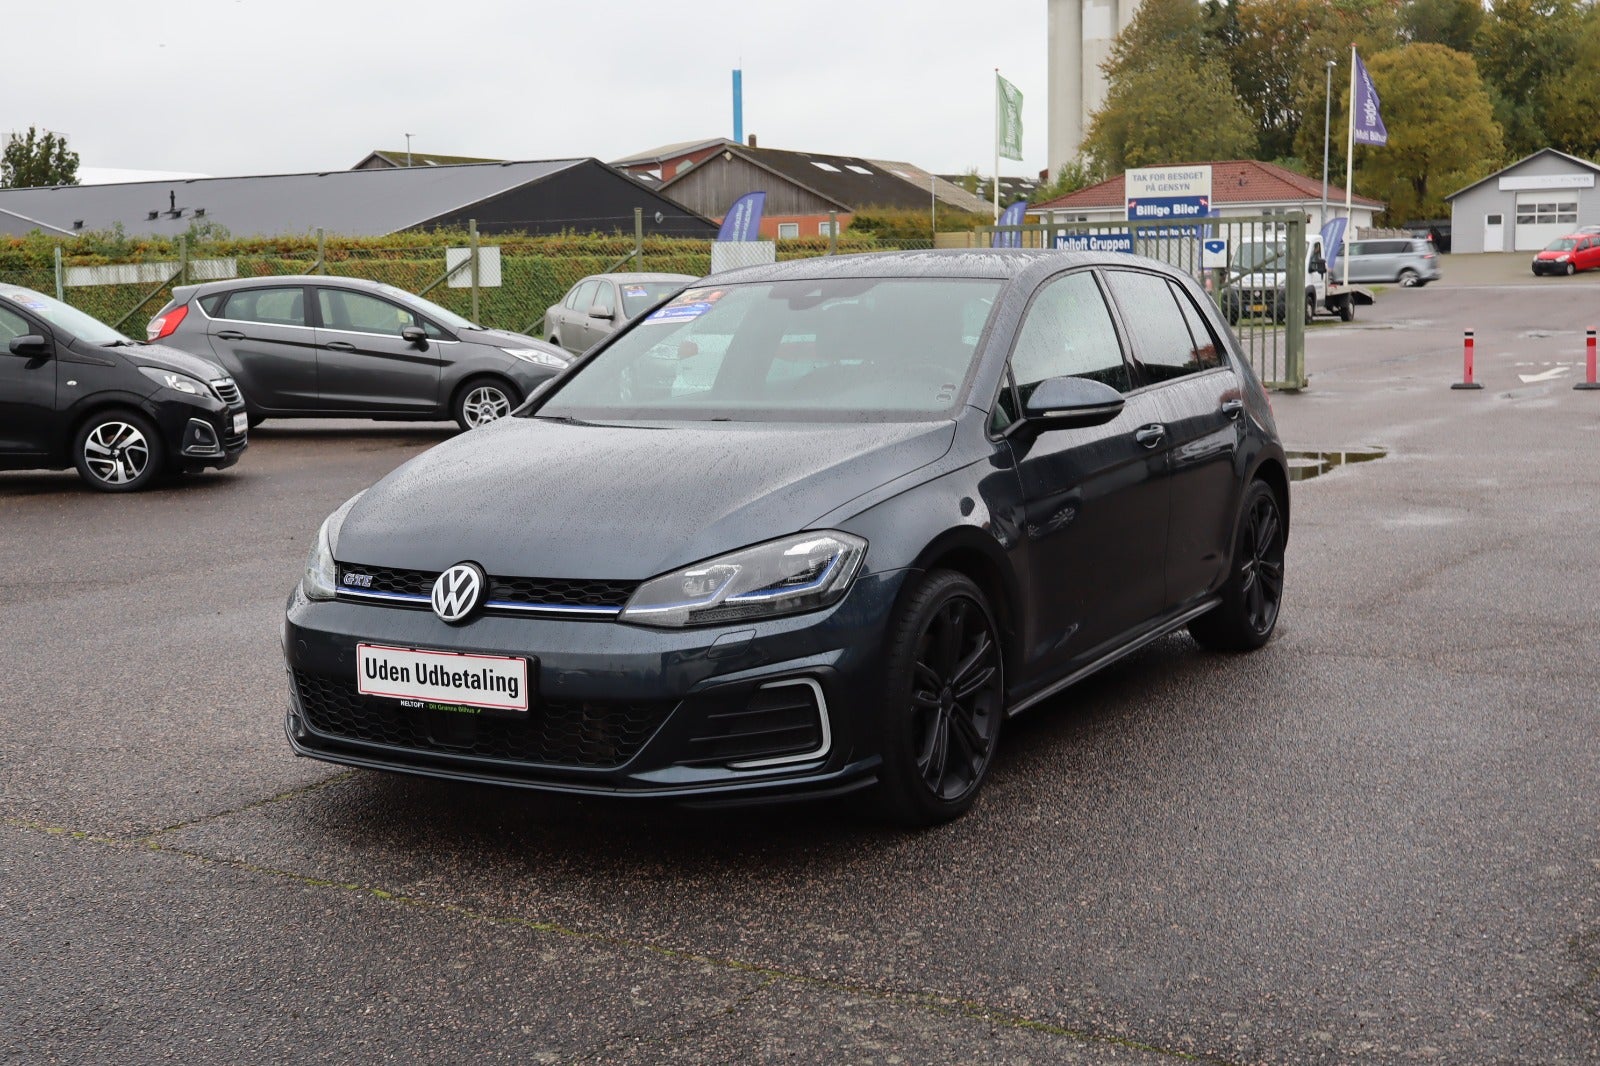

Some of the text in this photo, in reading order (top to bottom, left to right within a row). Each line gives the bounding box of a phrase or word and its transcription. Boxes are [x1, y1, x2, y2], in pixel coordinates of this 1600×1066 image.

[1150, 173, 1165, 181] FOR
[1168, 172, 1203, 180] BESØGET
[1146, 183, 1190, 192] PÅ GENSYN
[1136, 204, 1199, 217] Billige Biler
[1056, 237, 1131, 251] Neltoft Gruppen
[343, 572, 373, 588] GTE
[365, 657, 519, 699] Uden Udbetaling
[400, 700, 424, 708] NELTOFT
